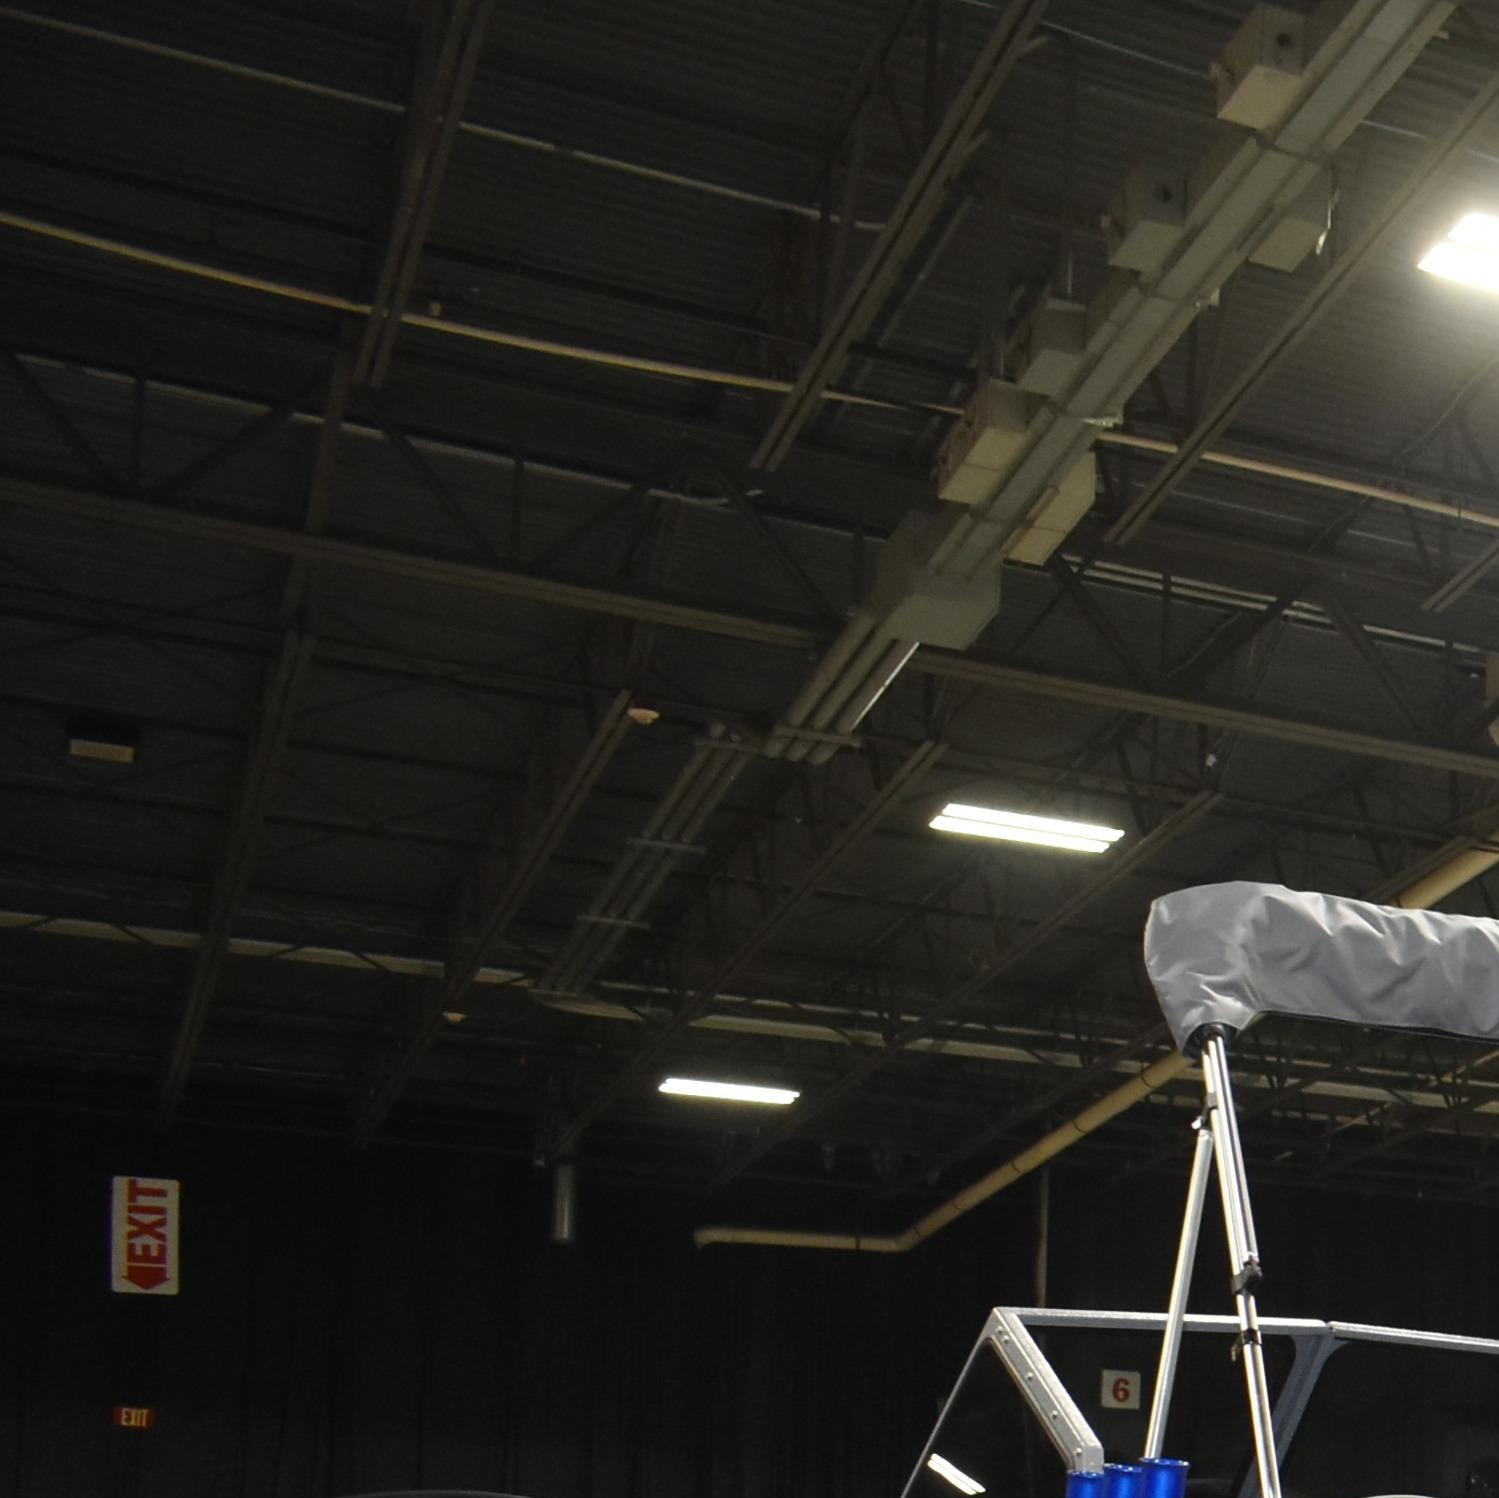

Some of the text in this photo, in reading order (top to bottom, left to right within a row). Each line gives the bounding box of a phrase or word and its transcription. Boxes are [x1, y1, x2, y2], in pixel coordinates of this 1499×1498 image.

[126, 1178, 168, 1265] EXIT
[1111, 1377, 1131, 1403] 6
[121, 1407, 149, 1427] EXIT
